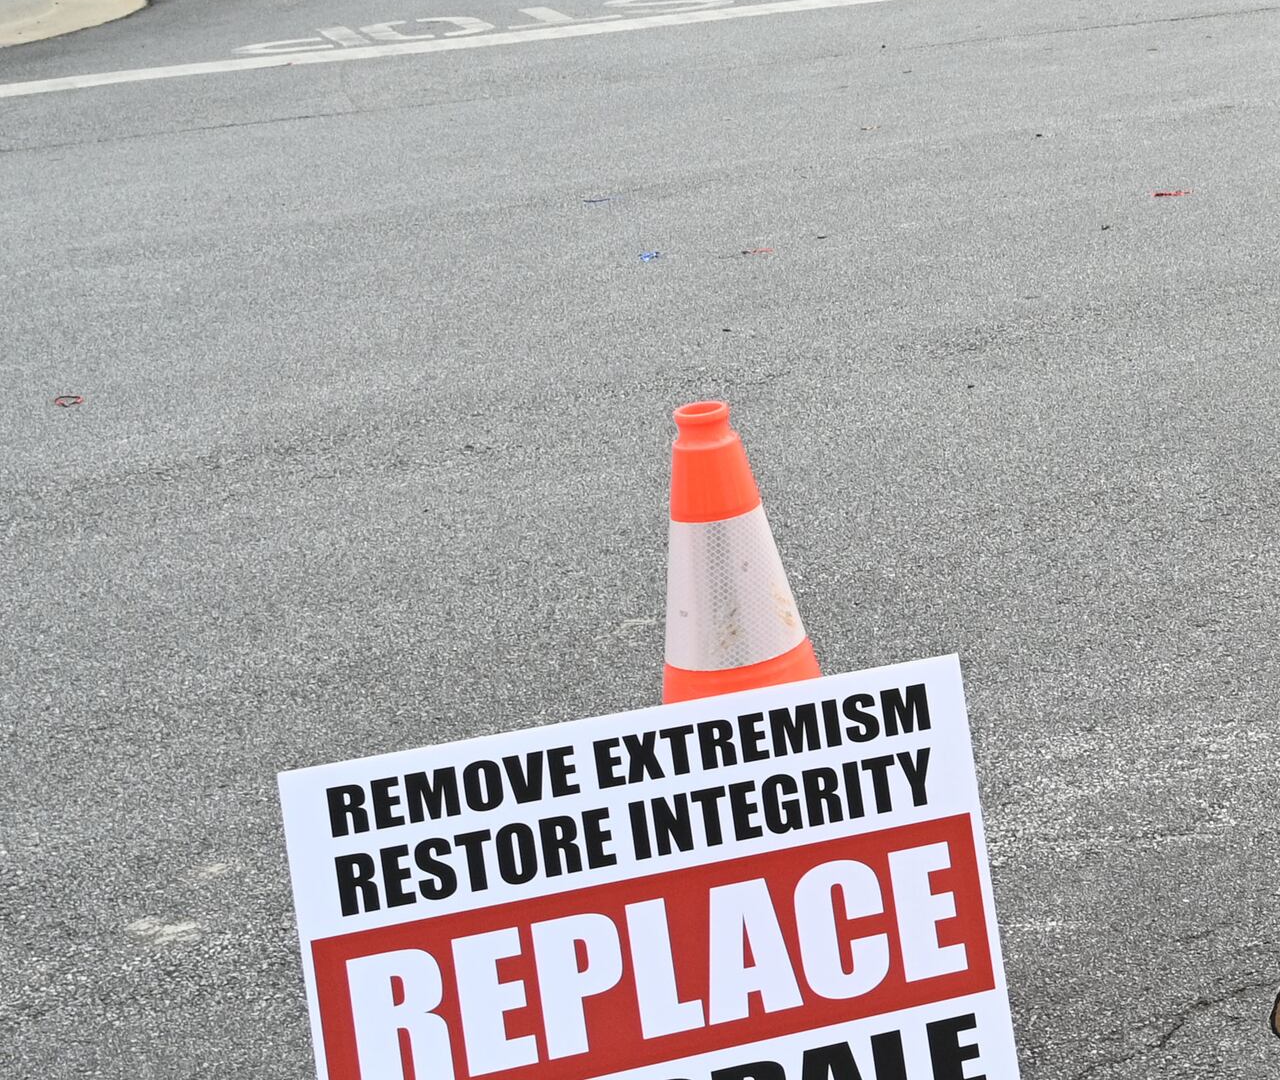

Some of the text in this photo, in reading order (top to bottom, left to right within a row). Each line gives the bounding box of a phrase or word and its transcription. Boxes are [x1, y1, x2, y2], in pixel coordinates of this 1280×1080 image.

[325, 682, 932, 838] REMOVE EXTREMISM
[333, 746, 932, 918] RESTORE INTEGRITY
[345, 840, 970, 1080] REPLACE
